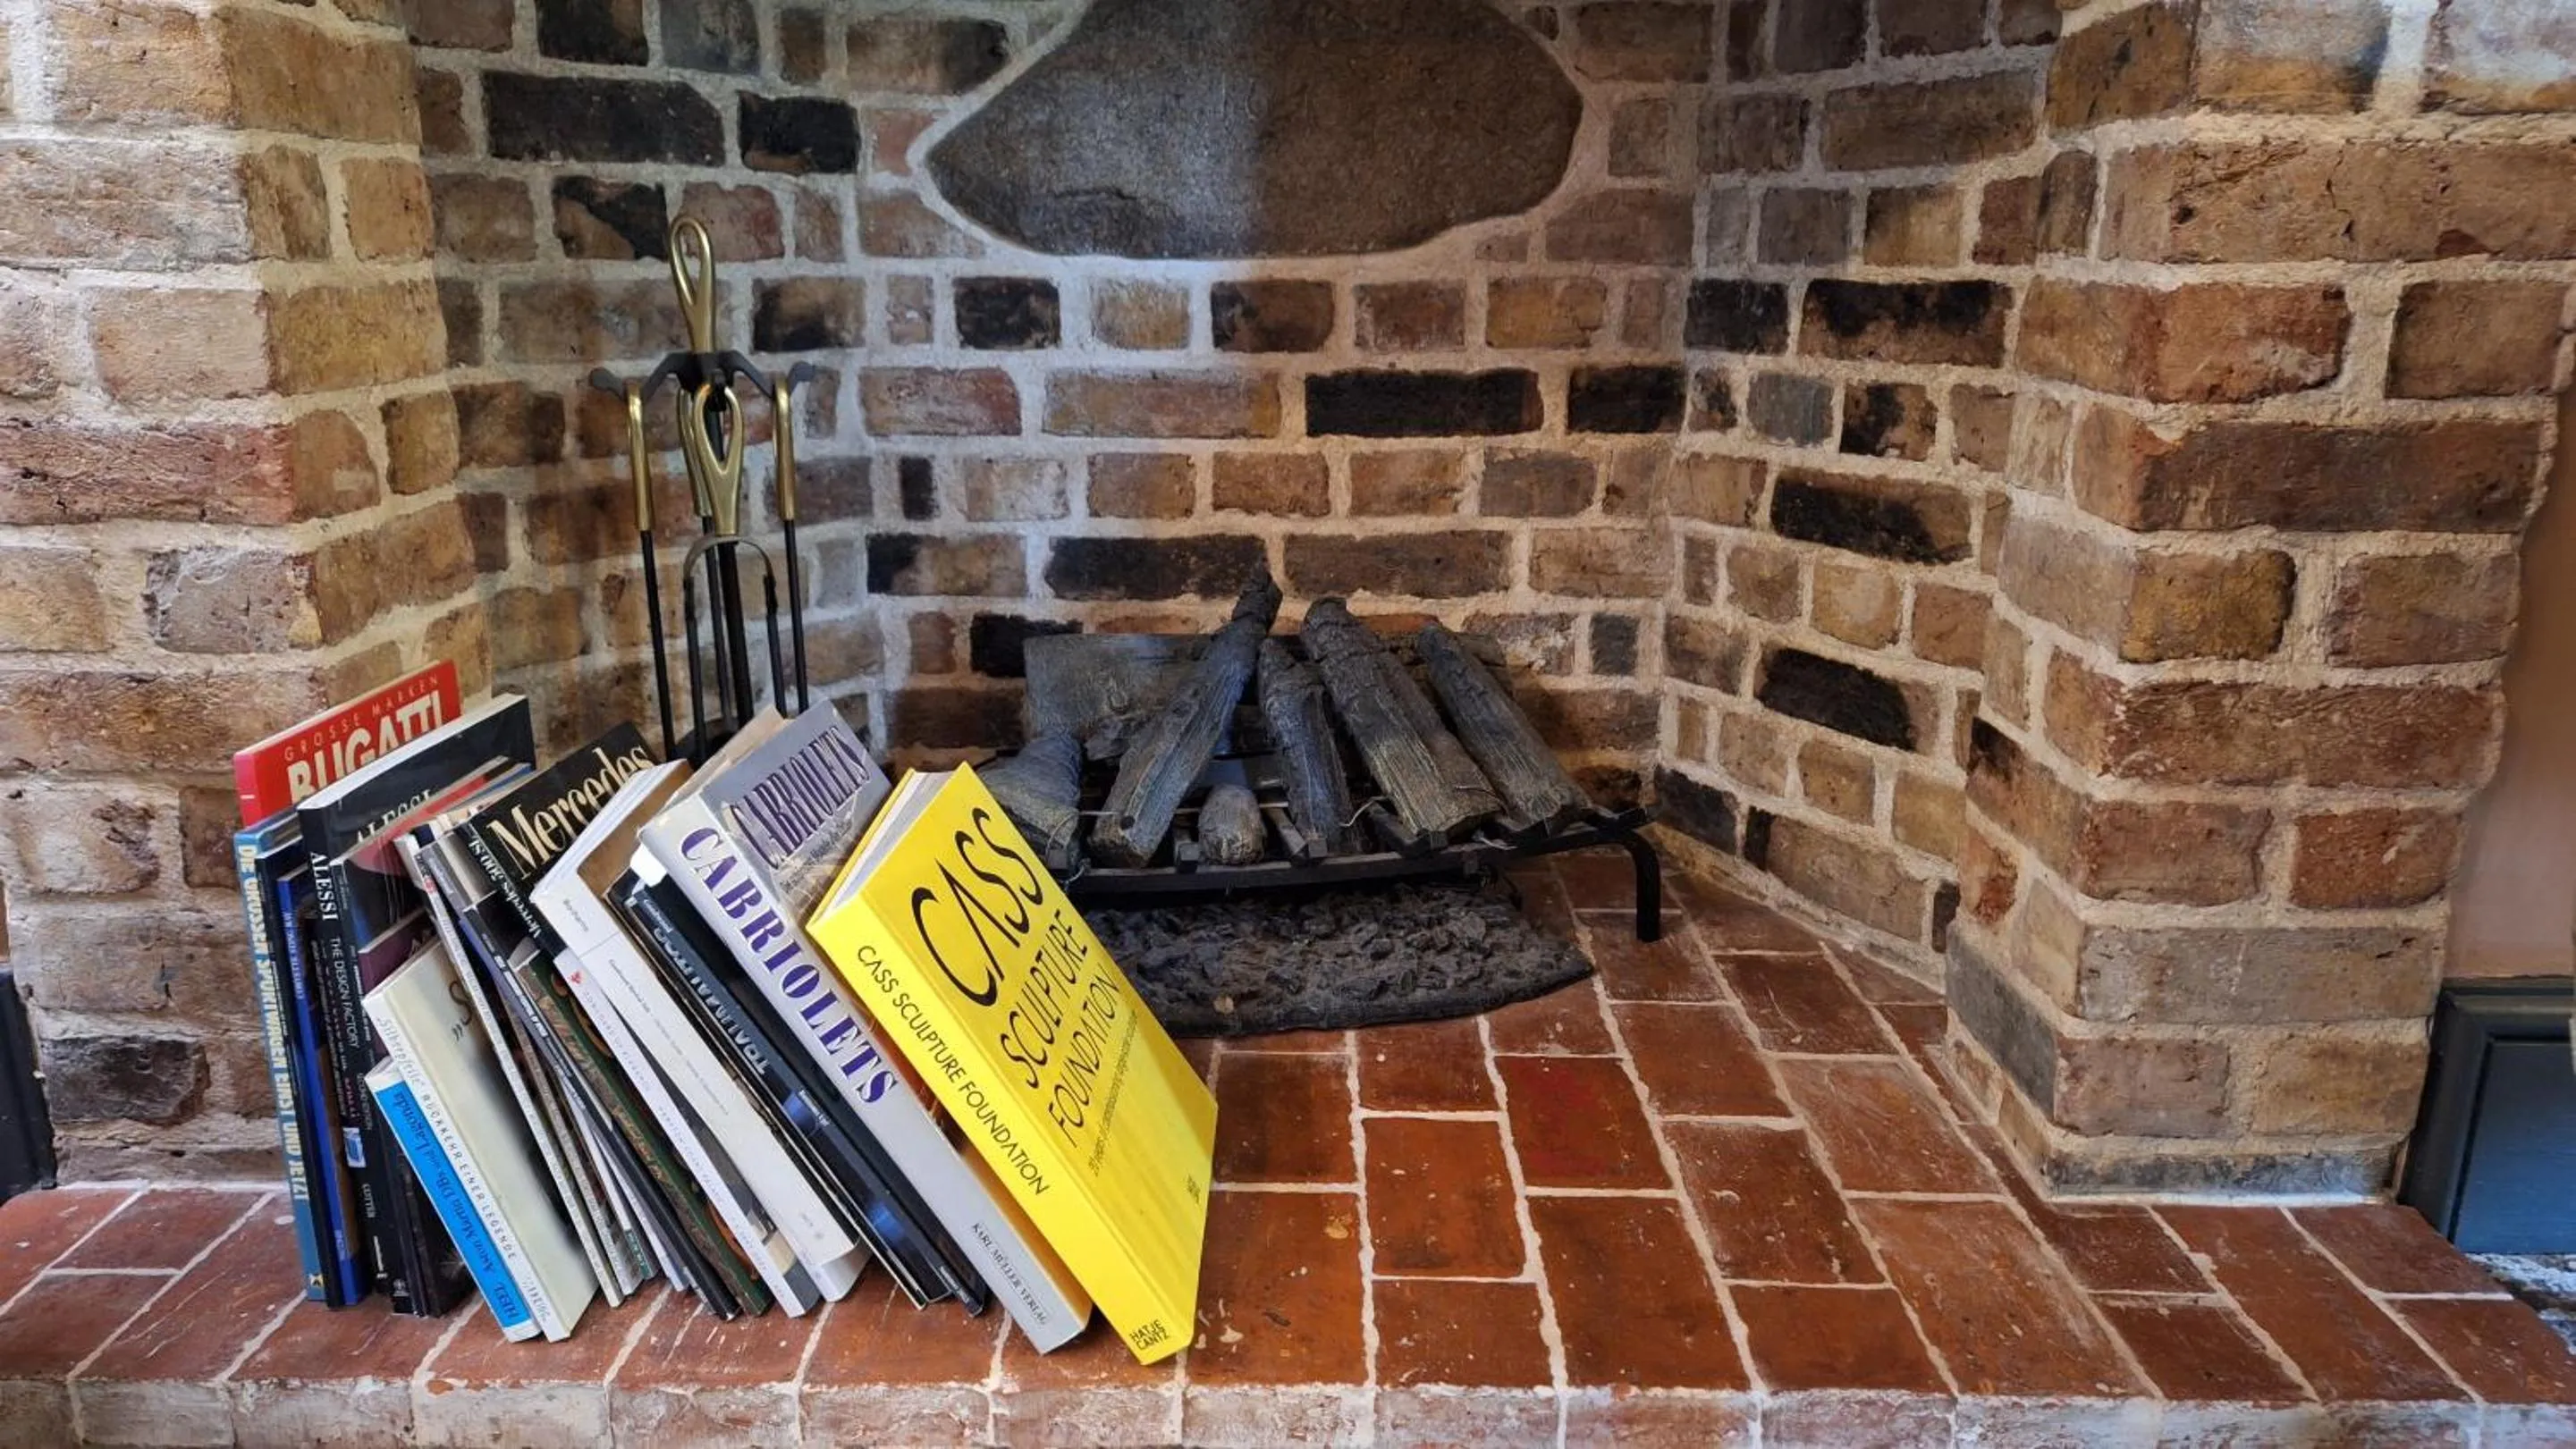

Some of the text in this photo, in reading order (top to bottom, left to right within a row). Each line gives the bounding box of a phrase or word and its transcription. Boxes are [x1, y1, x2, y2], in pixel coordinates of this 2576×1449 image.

[284, 676, 438, 761] GROSSE MARKEN
[287, 690, 443, 804] BUGATTI
[487, 744, 655, 879] Mercedes
[728, 725, 872, 870] CABRIOLETS
[310, 852, 339, 921] ALESSI
[912, 807, 1043, 1007] CASS
[329, 936, 344, 962] THE
[333, 960, 351, 998] DESIGN
[680, 827, 899, 1104] CABRIOLETS
[238, 843, 260, 873] DIE
[282, 1120, 301, 1158] UND
[341, 1000, 360, 1049] FACTORY
[1000, 909, 1087, 1089] SCULPTURE
[857, 944, 1051, 1195] CASS SCULPTURE FOUNDATION
[1048, 960, 1120, 1147] FOUNDATION
[386, 1091, 432, 1152] Lagonda
[448, 1198, 478, 1240] Martin
[469, 1239, 495, 1273] Aston
[1129, 1318, 1162, 1342] HATJE
[1136, 1329, 1169, 1350] CANTZ
